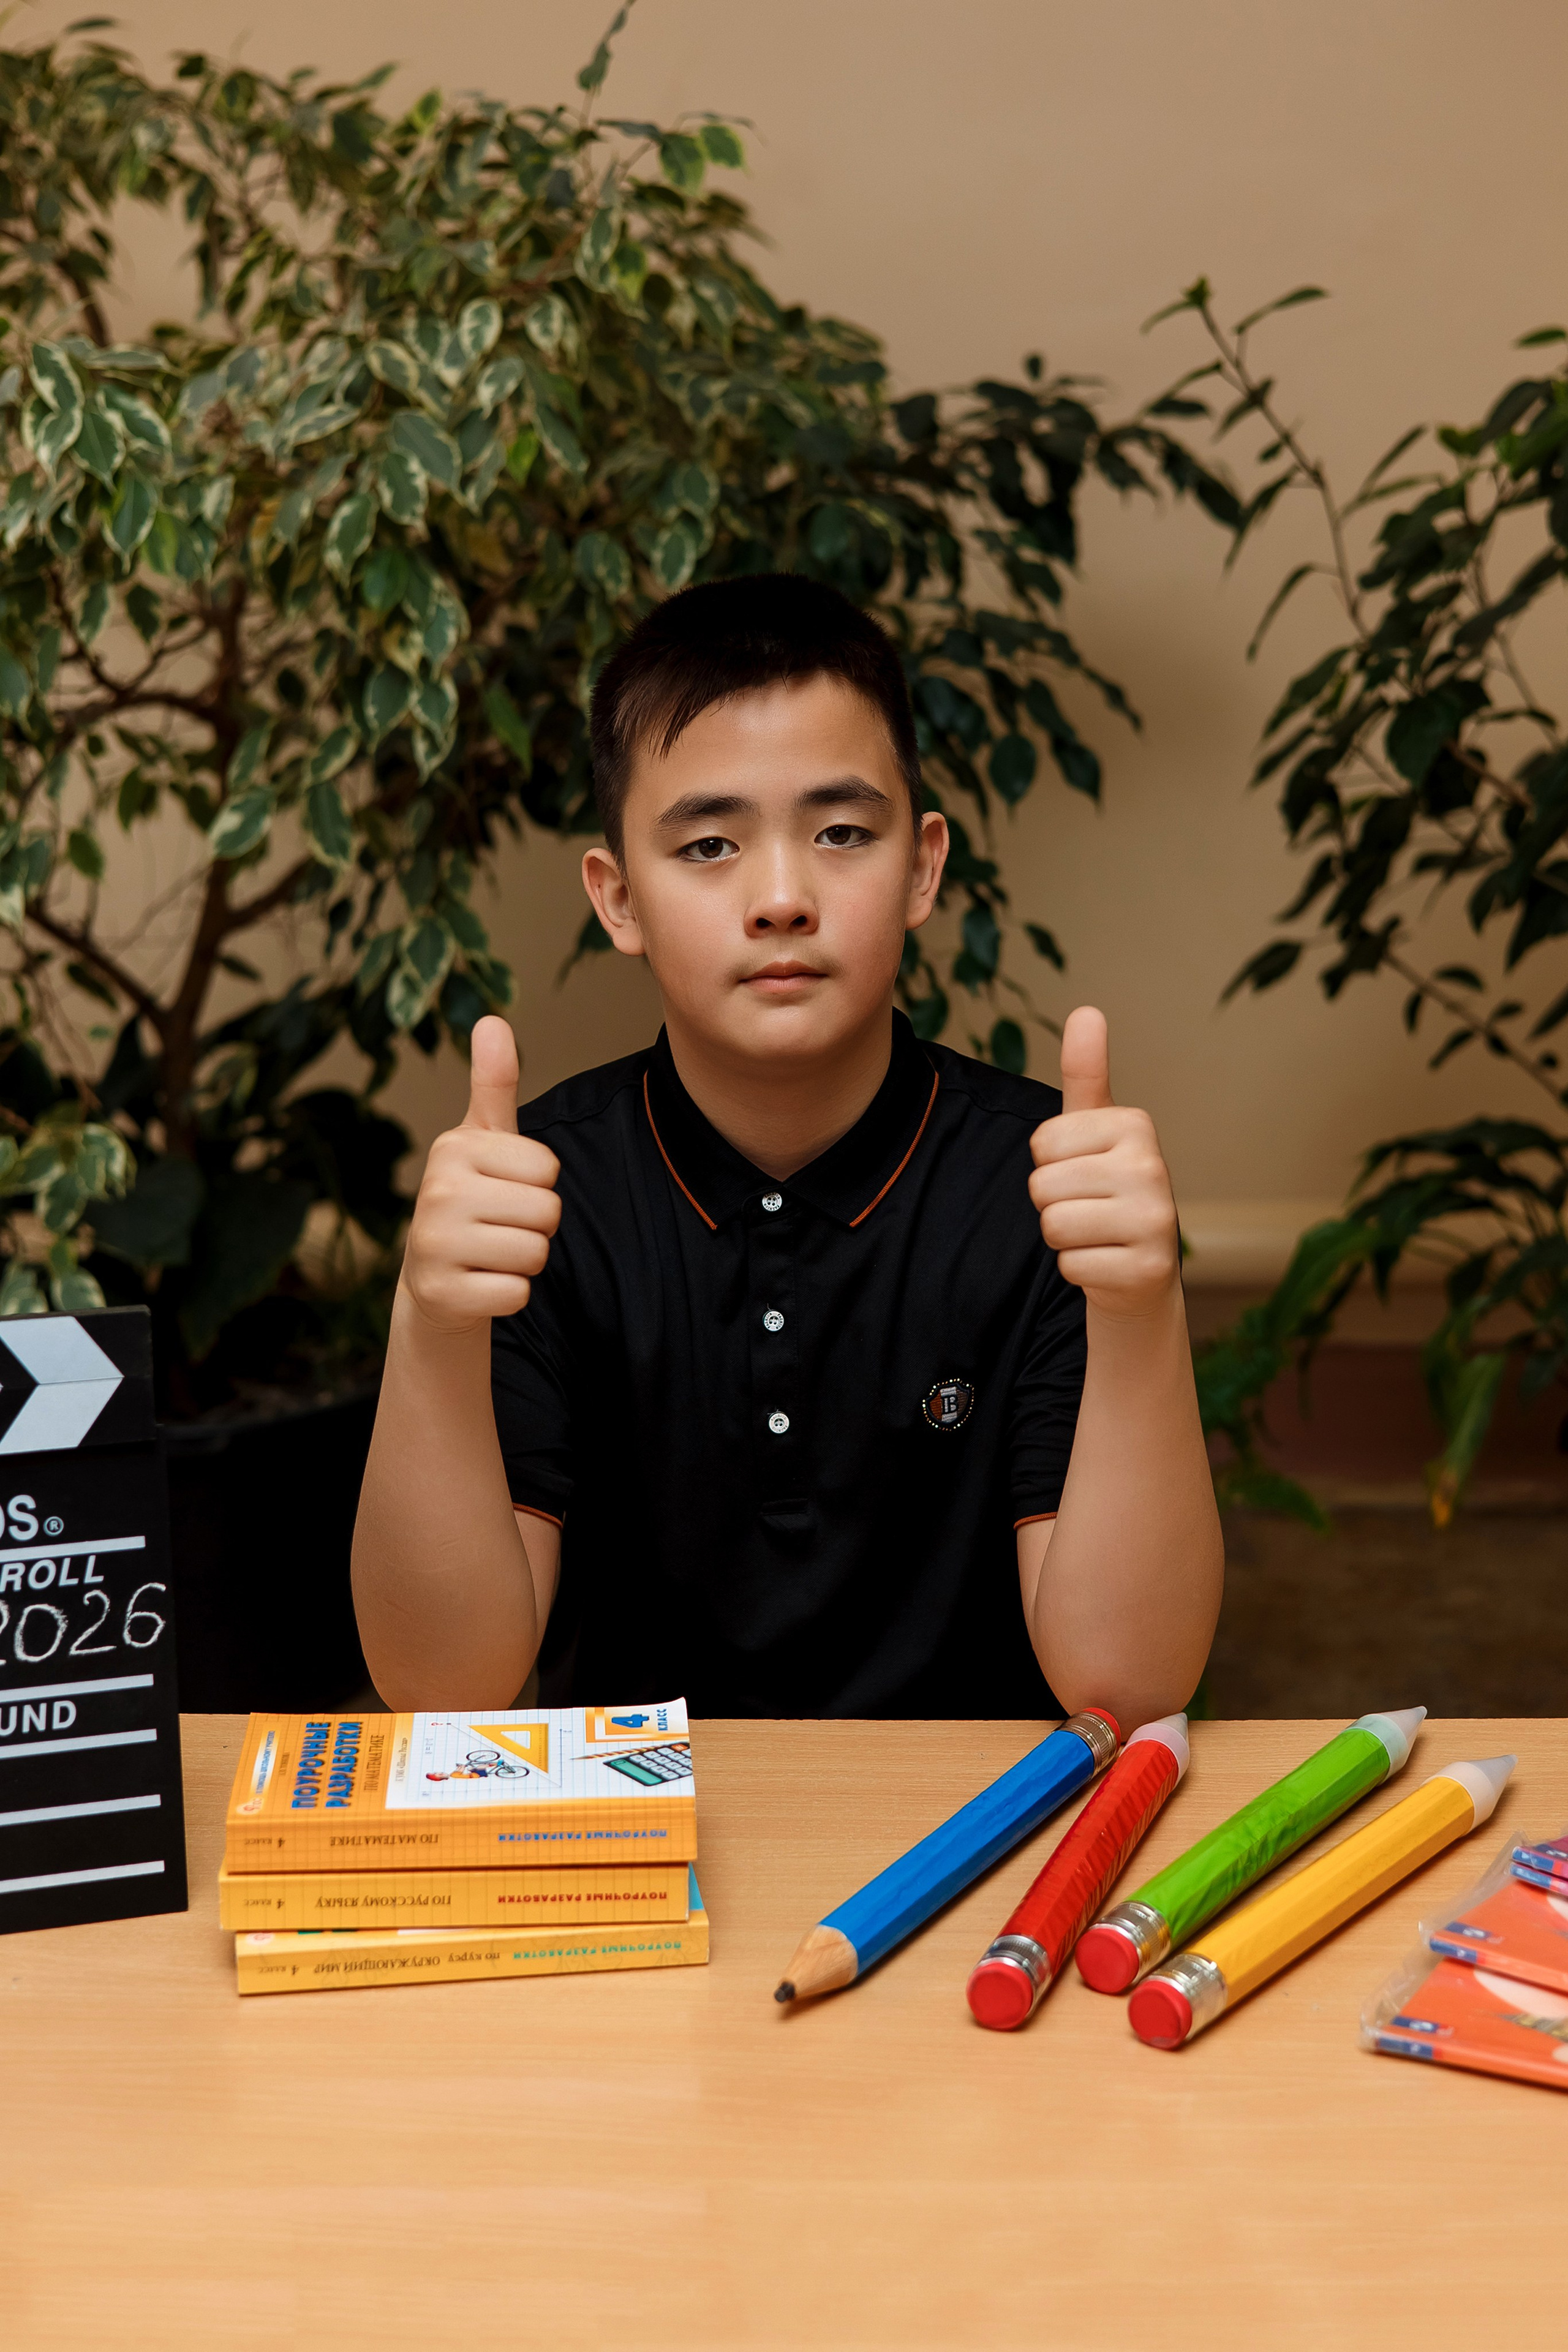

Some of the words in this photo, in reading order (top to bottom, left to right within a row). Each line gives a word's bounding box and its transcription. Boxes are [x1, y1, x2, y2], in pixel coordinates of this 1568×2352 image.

[0, 1555, 104, 1592] ROLL
[0, 1583, 166, 1666] 026
[611, 1713, 649, 1728] 4
[657, 1708, 668, 1731] КЛАСС
[366, 1735, 385, 1779] МАТЕМАТИКЕ
[291, 1722, 330, 1809] ПОУРОЧНЫЕ
[325, 1722, 363, 1809] РАЗРАБОТКИ
[364, 1779, 379, 1791] ПО
[420, 1834, 439, 1844] ПО
[498, 1832, 581, 1842] РАЗРАБОТКИ
[585, 1829, 668, 1839] ПОУРОЧНЫЕ
[278, 1837, 285, 1848] 4
[330, 1834, 417, 1847] МАТЕМАТИКЕ
[315, 1896, 359, 1908] ЯЗЫКУ
[361, 1894, 430, 1908] РУССКОМУ
[432, 1895, 451, 1905] ПО
[498, 1894, 581, 1904] РАЗРАБОТКИ
[586, 1891, 668, 1901] ПОУРОЧНЫЕ
[276, 1898, 285, 1909] 4
[513, 1948, 597, 1959] РАЗРАБОТКИ
[601, 1942, 682, 1954] ПОУРОЧНЫЕ
[448, 1951, 482, 1962] курсу
[291, 1965, 300, 1975] 4
[314, 1961, 340, 1973] МИР
[345, 1956, 440, 1972] ОКРУЖАЮЩИЙ
